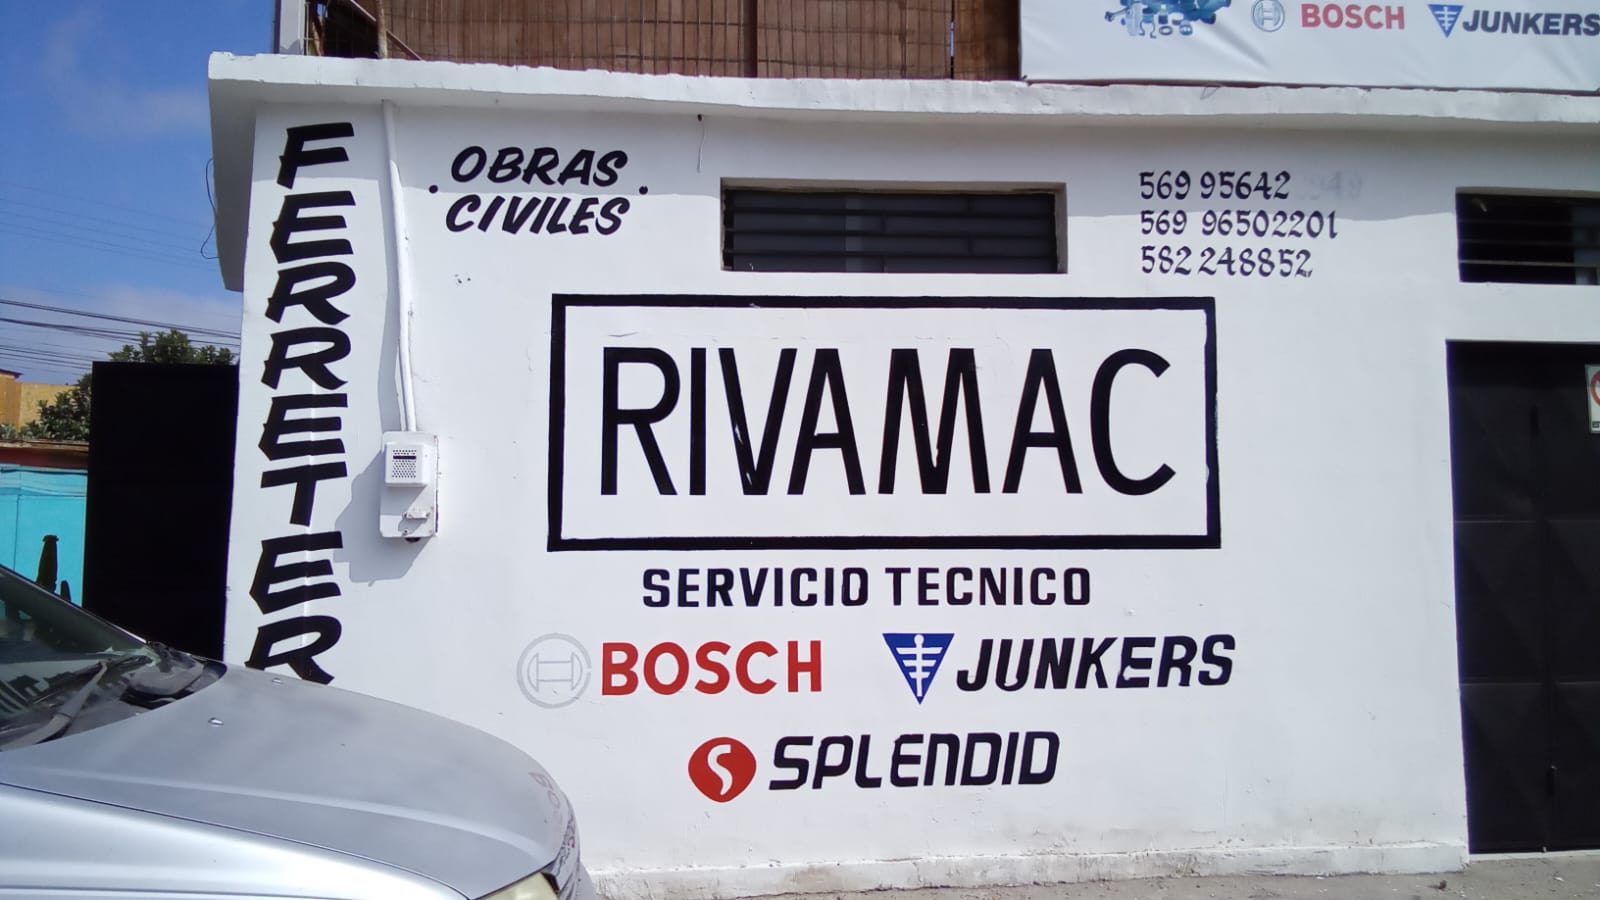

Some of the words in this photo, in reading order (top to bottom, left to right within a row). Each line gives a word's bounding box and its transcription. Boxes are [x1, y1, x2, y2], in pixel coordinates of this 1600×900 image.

[1301, 4, 1405, 30] BOSCH
[1462, 9, 1600, 37] JUNKERS
[450, 145, 629, 188] OBRAS
[1138, 169, 1192, 201] 569
[1199, 169, 1292, 201] 95642
[445, 194, 631, 236] CIVILES
[1139, 209, 1188, 236] 569
[1202, 208, 1338, 240] 96502201
[1140, 245, 1193, 276] 582
[600, 346, 1176, 496] RIVAMAC
[642, 567, 869, 608] SERVICIO
[884, 567, 1091, 606] TECNICO
[601, 640, 822, 696] BOSCH
[956, 634, 1236, 692] JUNKERS
[768, 731, 1060, 791] SPLENDID
